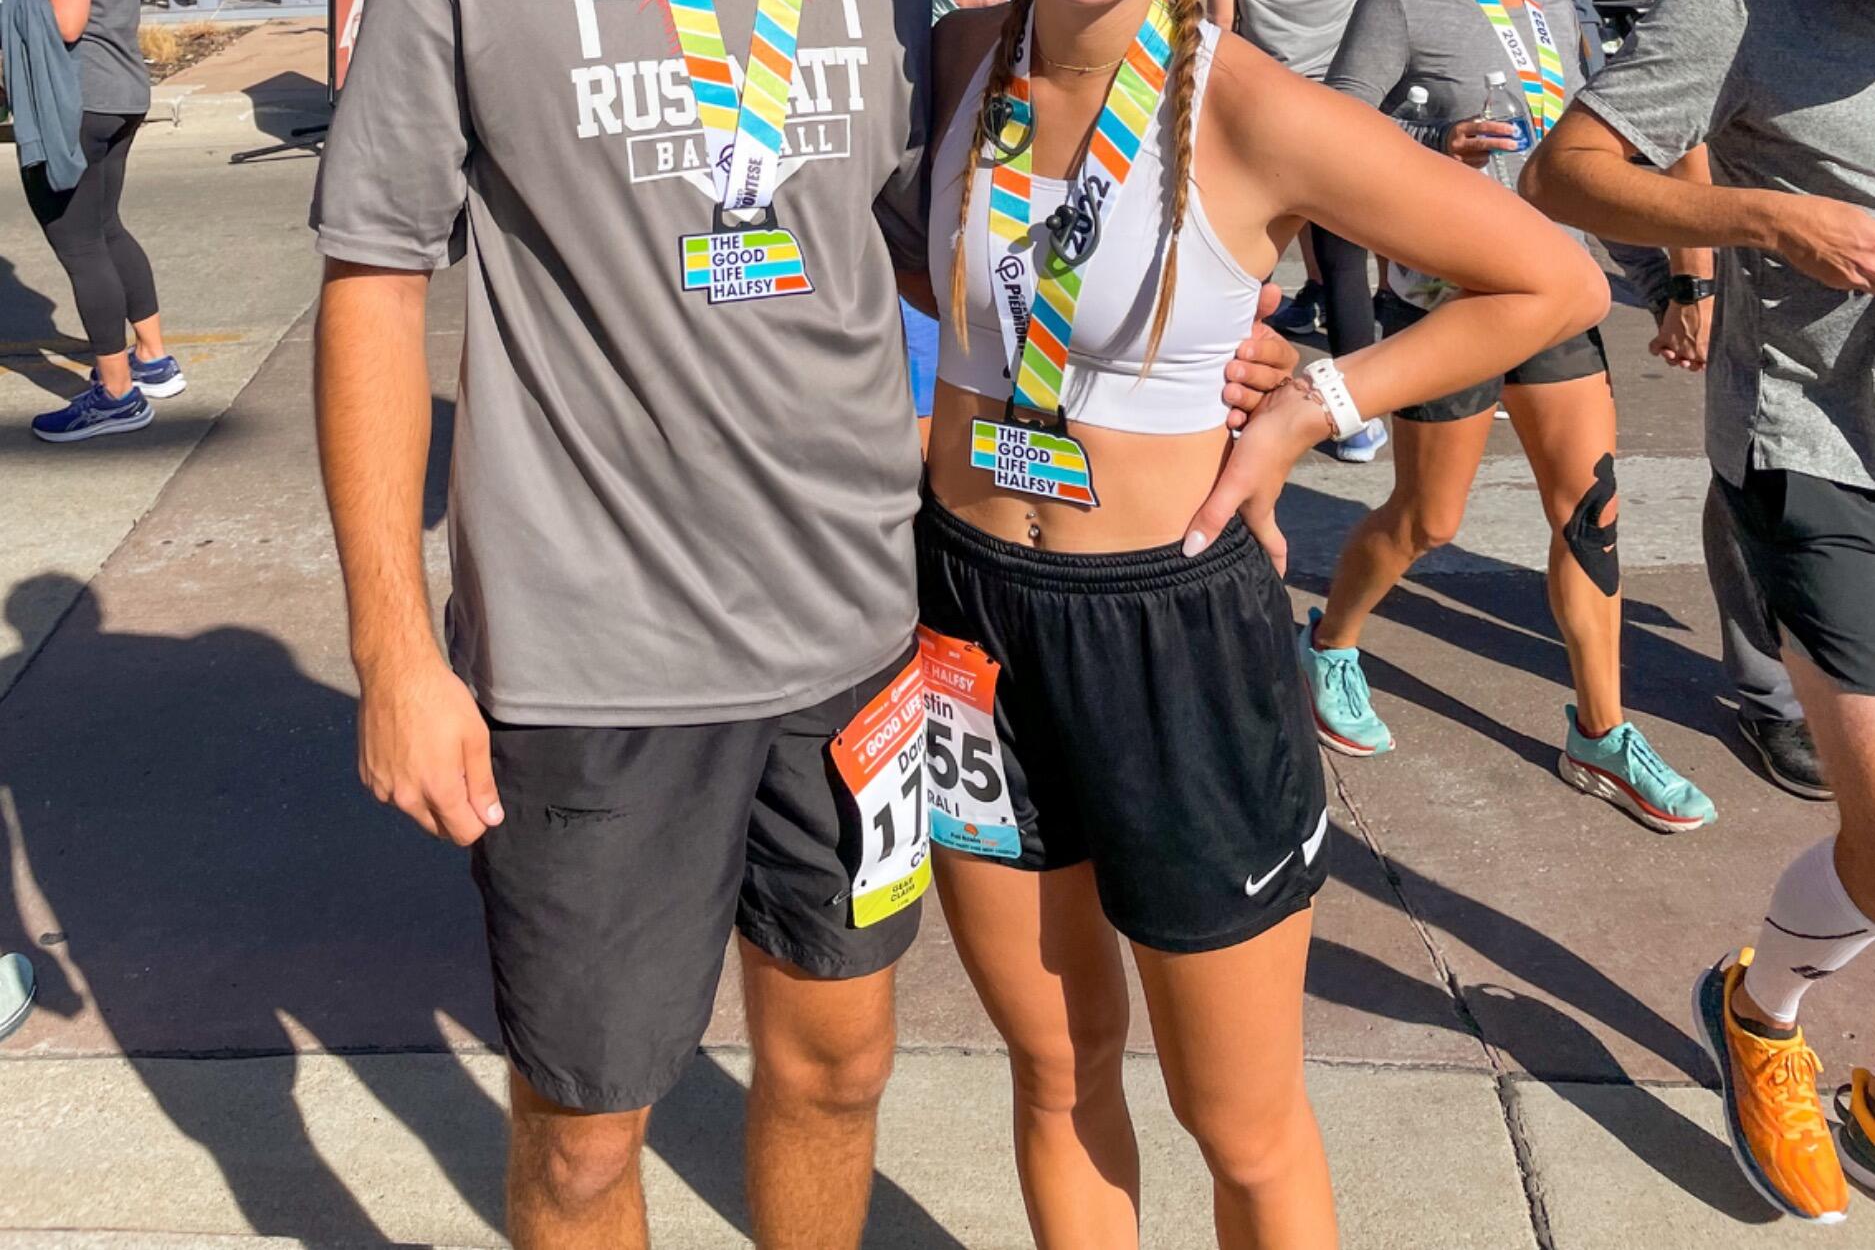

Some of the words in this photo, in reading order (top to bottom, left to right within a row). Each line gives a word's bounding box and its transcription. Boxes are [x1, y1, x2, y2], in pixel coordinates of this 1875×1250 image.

[1502, 29, 1528, 66] 2022
[656, 124, 833, 172] BAALL
[711, 235, 740, 251] THE
[711, 248, 765, 267] GOOD
[712, 266, 743, 283] LIFE
[714, 278, 773, 299] HALFSY
[998, 427, 1027, 445] THE
[998, 442, 1051, 463] GOOD
[998, 456, 1027, 474] LIFE
[998, 470, 1056, 494] HALFSY
[931, 663, 975, 692] HALFSY
[866, 717, 901, 757] GOOD
